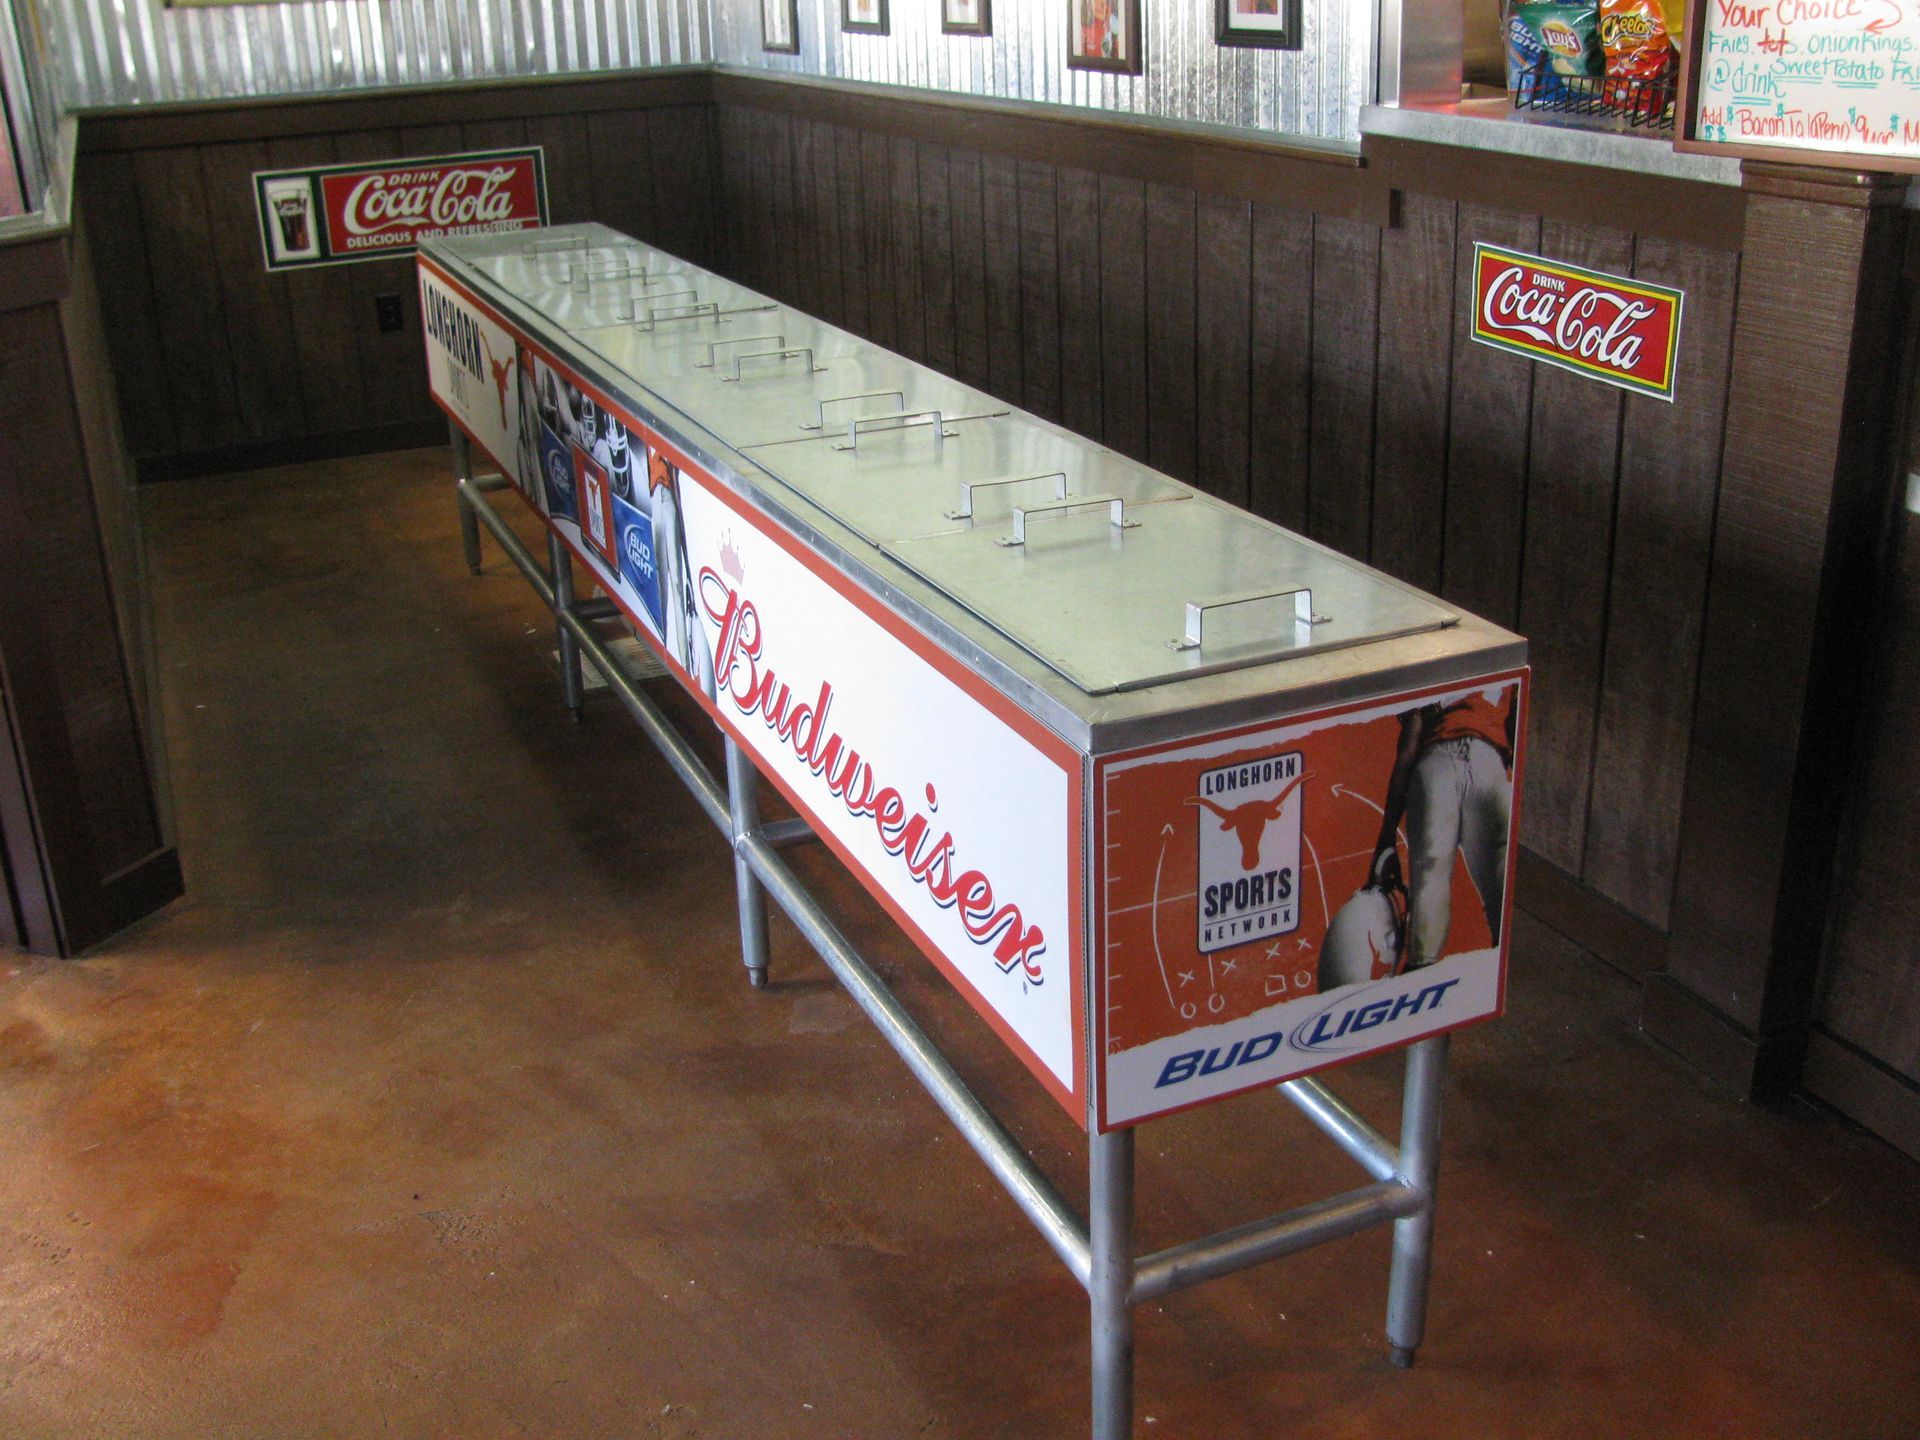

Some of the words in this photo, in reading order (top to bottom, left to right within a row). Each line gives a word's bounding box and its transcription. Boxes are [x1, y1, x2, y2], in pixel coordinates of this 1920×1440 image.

[1717, 0, 1770, 28] Your
[1769, 57, 1831, 76] Sweet
[389, 171, 440, 186] DRINK
[343, 166, 517, 235] Coca-Cola
[346, 231, 412, 248] DELICIOUS
[1532, 273, 1566, 293] DRINK
[423, 278, 485, 385] LONGHORN
[1483, 266, 1656, 370] Coca-Cola
[628, 544, 654, 579] LIGHT
[630, 532, 651, 562] BUD
[699, 565, 1047, 985] Budweiser
[1205, 756, 1296, 797] LONGHORN
[1204, 867, 1292, 919] SPORTS
[1204, 909, 1292, 943] NETWORK
[1153, 1031, 1284, 1089] BUD
[1301, 978, 1460, 1046] LIGHT
